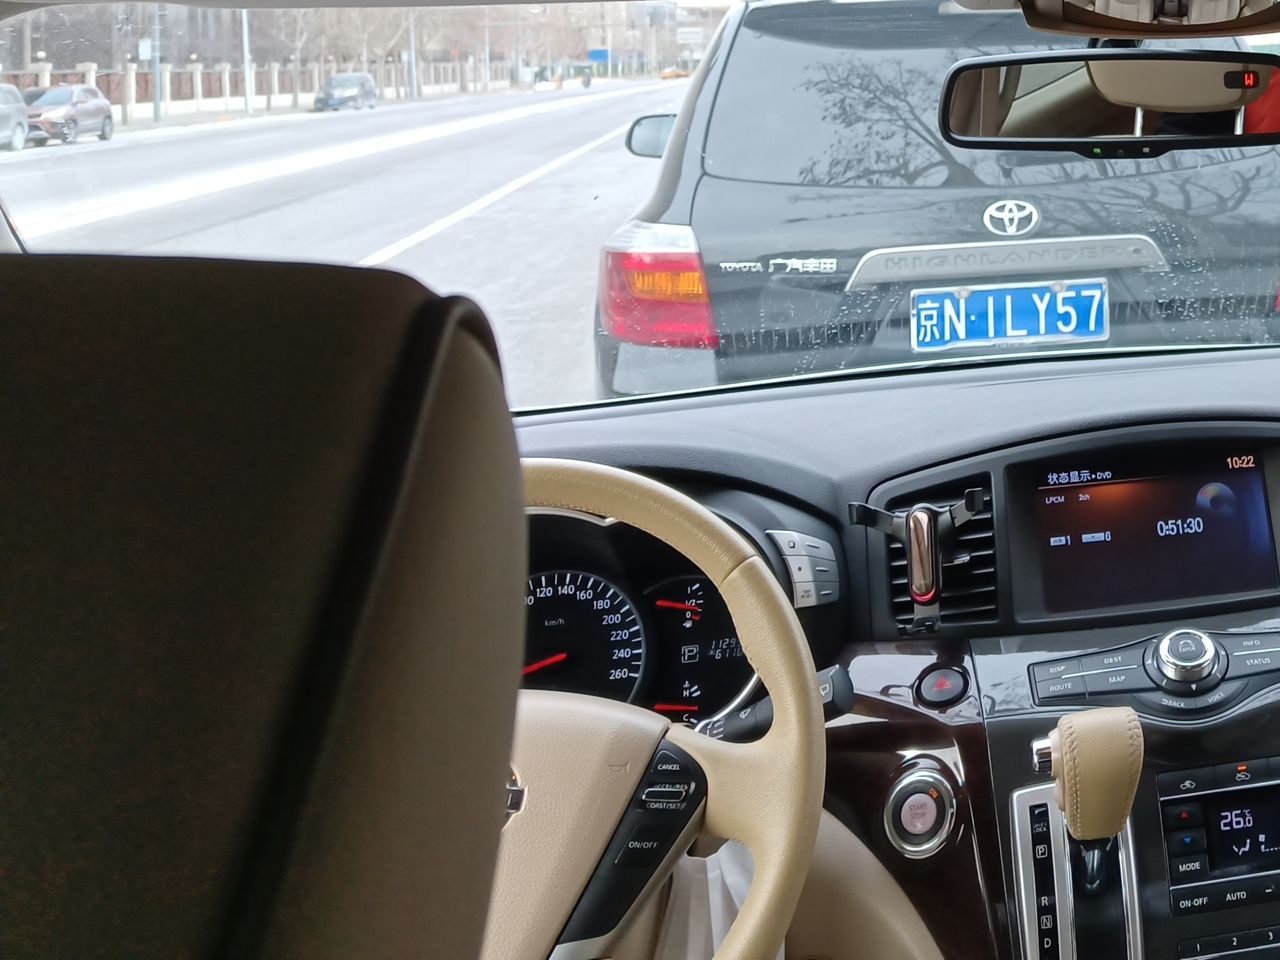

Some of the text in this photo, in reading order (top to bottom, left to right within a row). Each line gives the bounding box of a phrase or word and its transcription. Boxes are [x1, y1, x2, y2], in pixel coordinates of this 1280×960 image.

[720, 259, 837, 273] TOYOTA 广汽丰田
[1226, 455, 1255, 469] 10:22
[1047, 470, 1112, 485] 状态显示 DVD
[1045, 495, 1065, 504] LPCM
[1157, 517, 1203, 536] 0:51:30
[536, 587, 553, 597] 120
[558, 585, 575, 595] 140
[576, 590, 593, 600] 160
[593, 600, 610, 610] 180
[544, 618, 565, 627] km/h
[602, 614, 621, 625] 200
[610, 630, 629, 641] 220
[612, 648, 631, 659] 240
[1103, 656, 1122, 664] DEST
[1246, 657, 1271, 666] STATUS
[609, 668, 629, 680] 260
[1108, 675, 1125, 683] MAP
[1049, 683, 1072, 691] ROUTE
[628, 841, 658, 849] ON/OFF
[1179, 862, 1200, 872] MODE
[1041, 896, 1048, 906] R
[1226, 891, 1247, 901] AUTO
[1232, 937, 1237, 945] 2
[1268, 932, 1273, 940] 3
[1044, 938, 1051, 948] D
